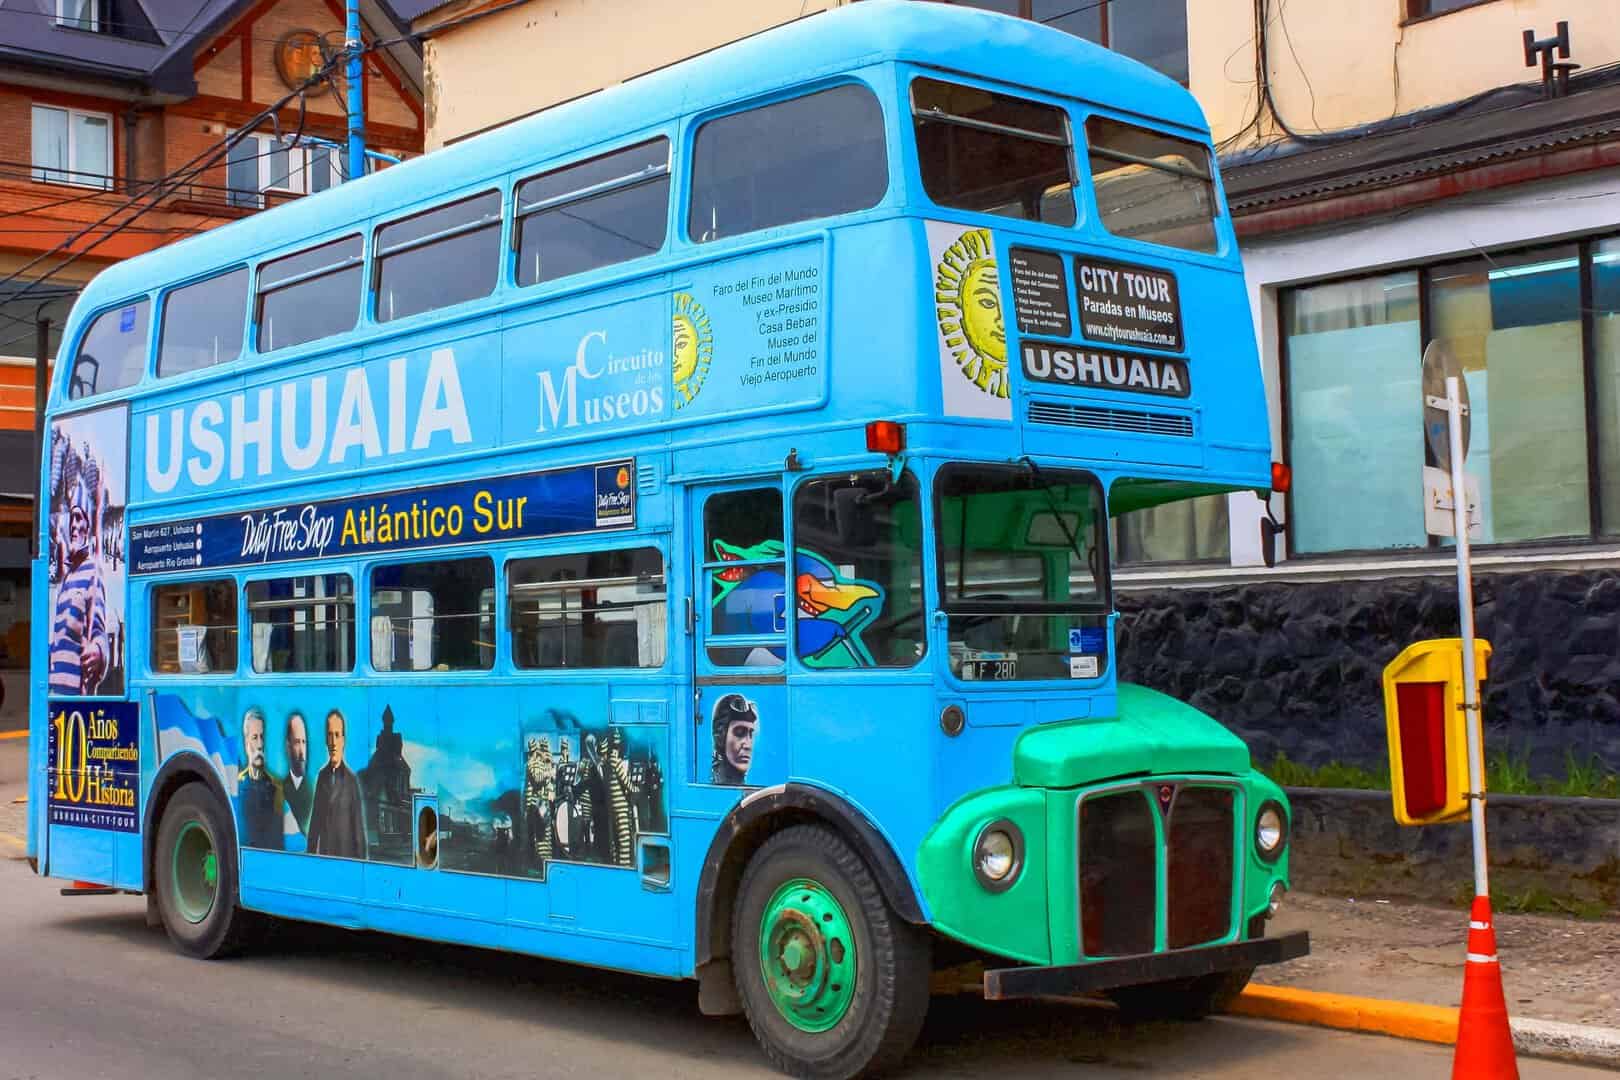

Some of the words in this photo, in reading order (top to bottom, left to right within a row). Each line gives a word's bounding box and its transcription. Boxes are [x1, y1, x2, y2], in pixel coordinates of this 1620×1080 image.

[713, 284, 733, 297] Faro
[735, 279, 749, 292] del
[751, 276, 765, 288] Fin
[768, 271, 782, 286] del
[785, 267, 818, 282] Mundo
[1080, 265, 1119, 295] CITY
[1123, 272, 1171, 303] TOUR
[742, 292, 773, 306] Museo
[756, 311, 762, 322] y
[764, 300, 818, 318] ex-Presidio
[1083, 296, 1122, 317] Paradas
[1125, 305, 1137, 318] en
[1138, 303, 1174, 324] Museos
[759, 322, 783, 336] Casa
[786, 316, 817, 330] Beban
[768, 336, 800, 349] Museo
[802, 331, 817, 344] del
[575, 330, 664, 379] Circuito
[750, 356, 764, 369] Fin
[767, 352, 783, 366] del
[784, 348, 817, 363] Mundo
[740, 373, 762, 387] Viejo
[764, 364, 817, 383] Aeropuerto
[1025, 348, 1183, 392] USHUAIA
[536, 365, 664, 433] Museos
[145, 348, 473, 494] USHUAIA
[340, 500, 463, 546] Atlántico
[473, 490, 528, 533] Sur
[240, 515, 273, 563] Duty
[272, 508, 298, 552] Free
[297, 505, 335, 558] Shop
[993, 661, 1016, 681] 280
[88, 709, 118, 740] Años
[54, 710, 87, 803] 10
[87, 740, 138, 762] Compartiendo
[86, 765, 135, 808] Historia
